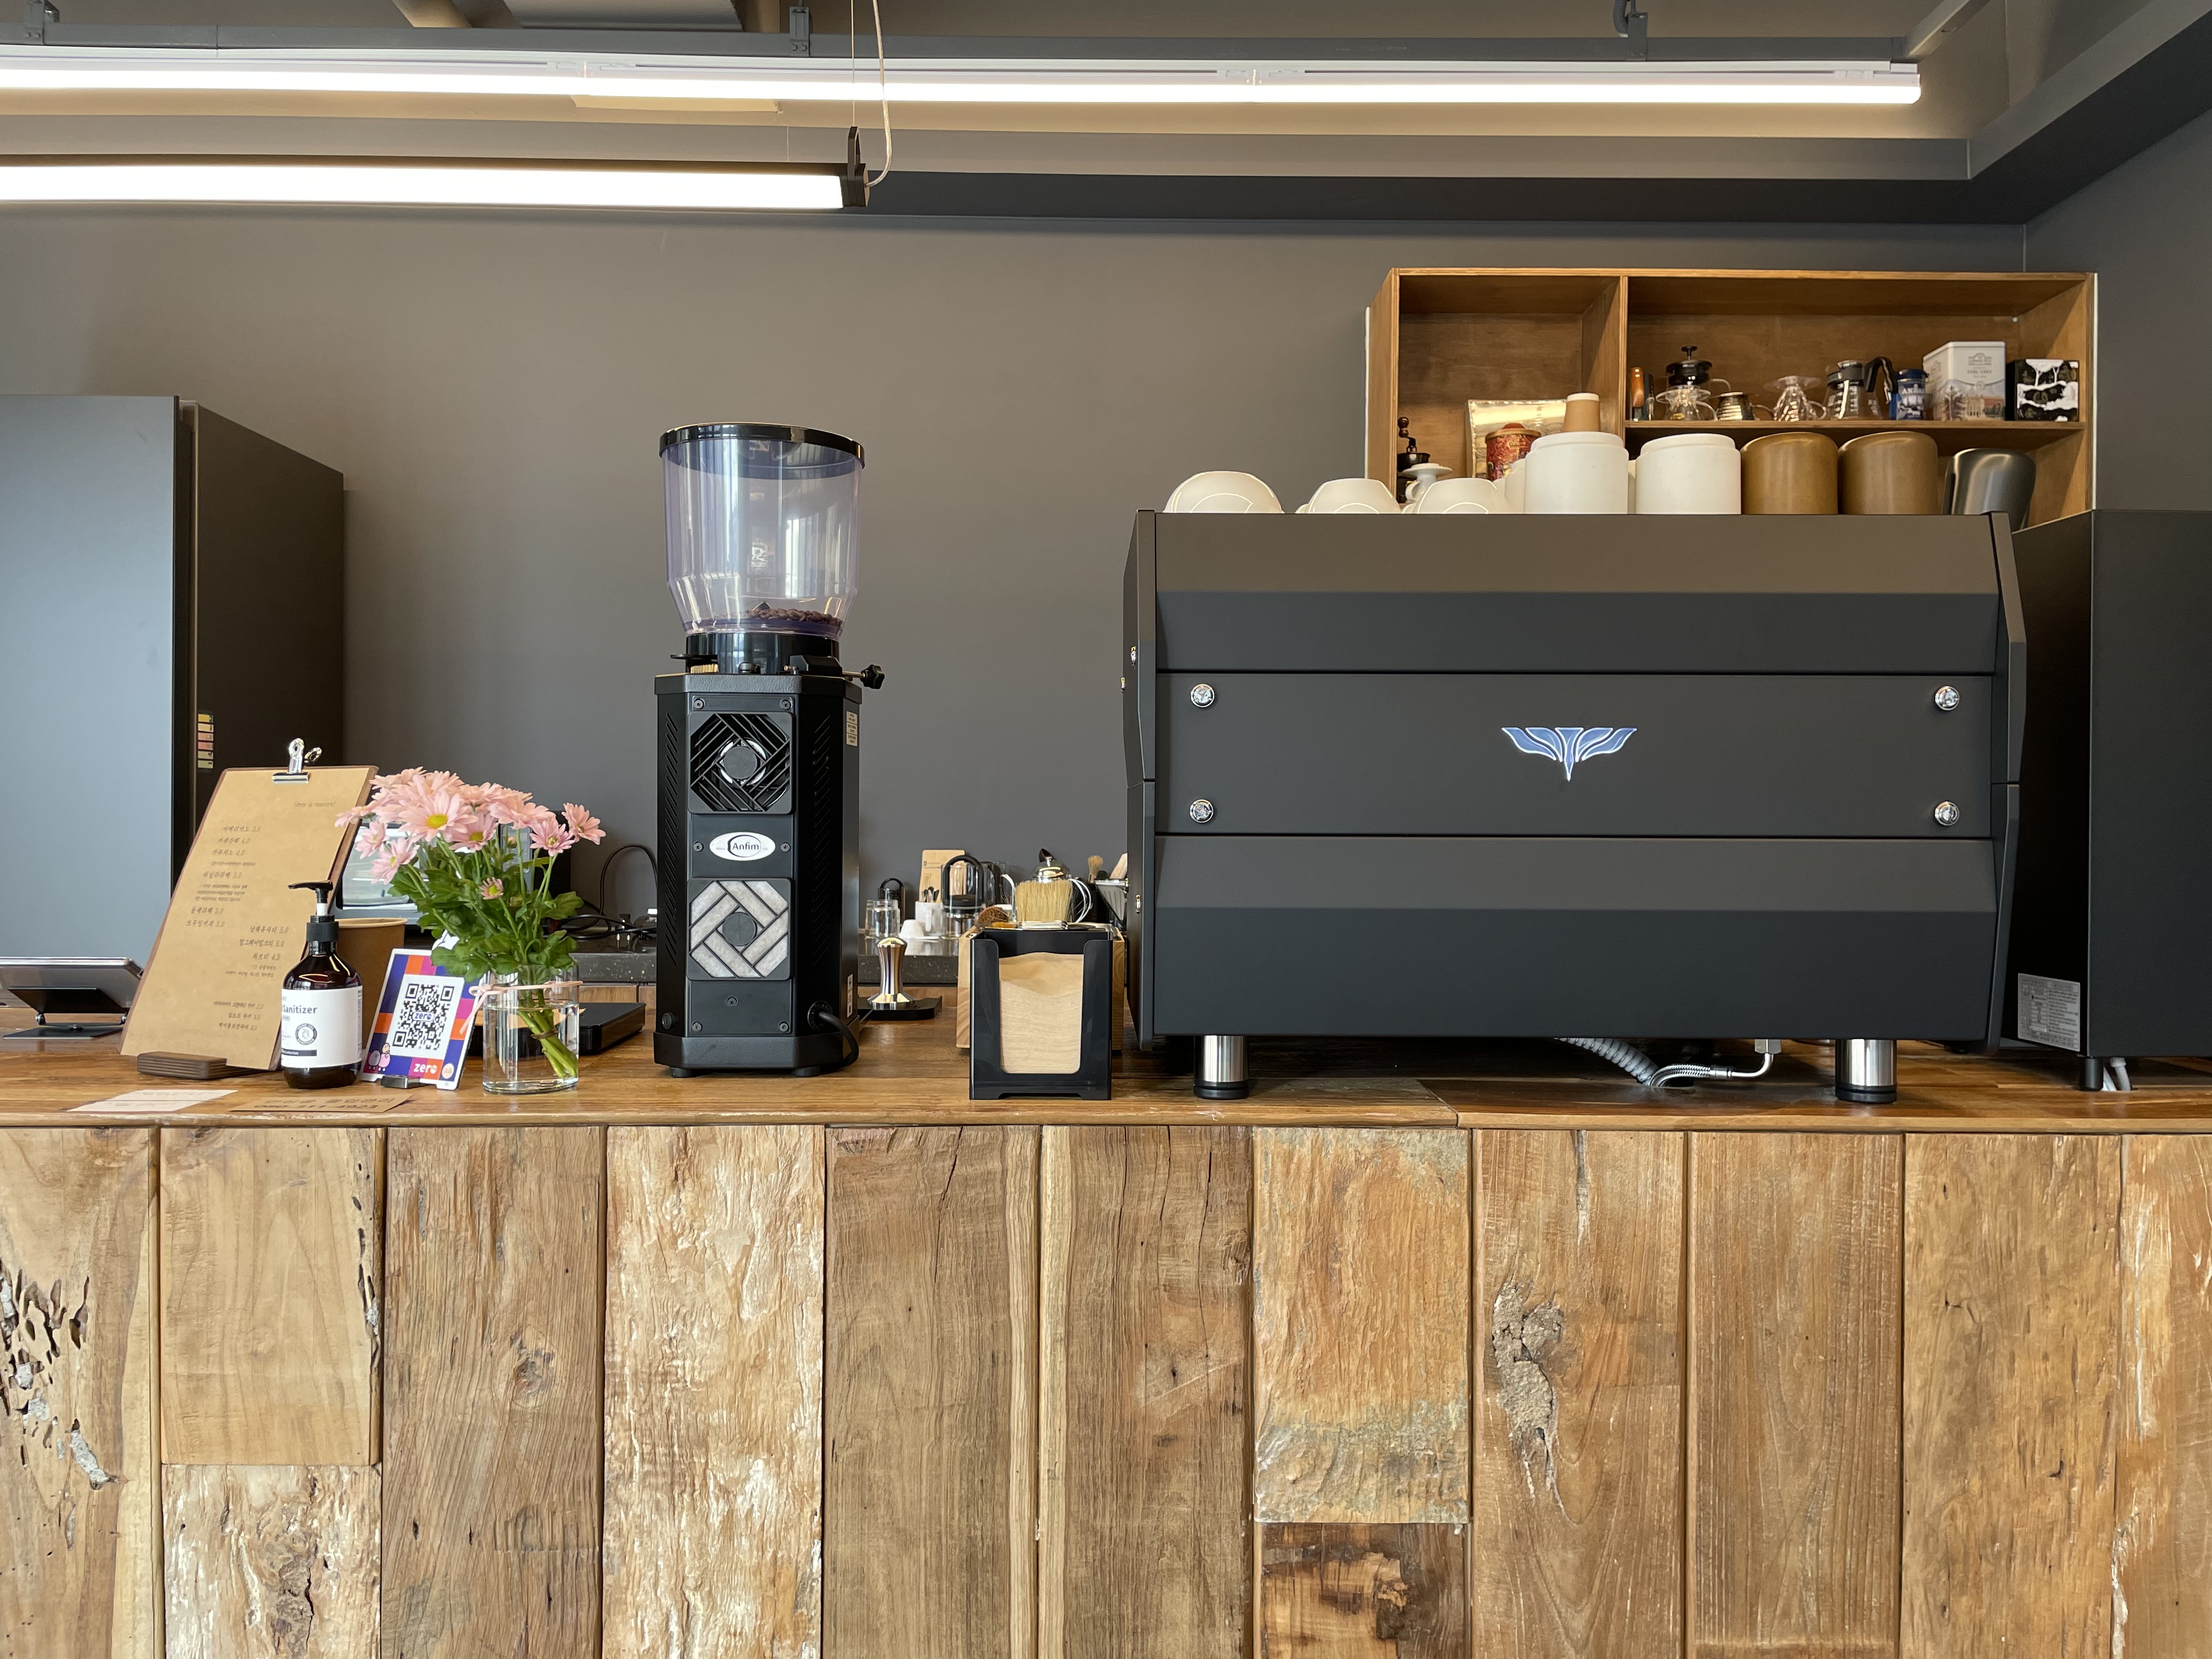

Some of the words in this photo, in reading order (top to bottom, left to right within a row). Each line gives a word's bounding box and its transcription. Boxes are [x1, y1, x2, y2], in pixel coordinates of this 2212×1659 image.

[732, 842, 759, 850] Anfim
[239, 939, 274, 947] 얼그레이밀크티
[253, 952, 269, 961] 허브티
[283, 1005, 318, 1014] Sanitizer
[414, 1012, 432, 1020] zero
[413, 1063, 438, 1074] zero
